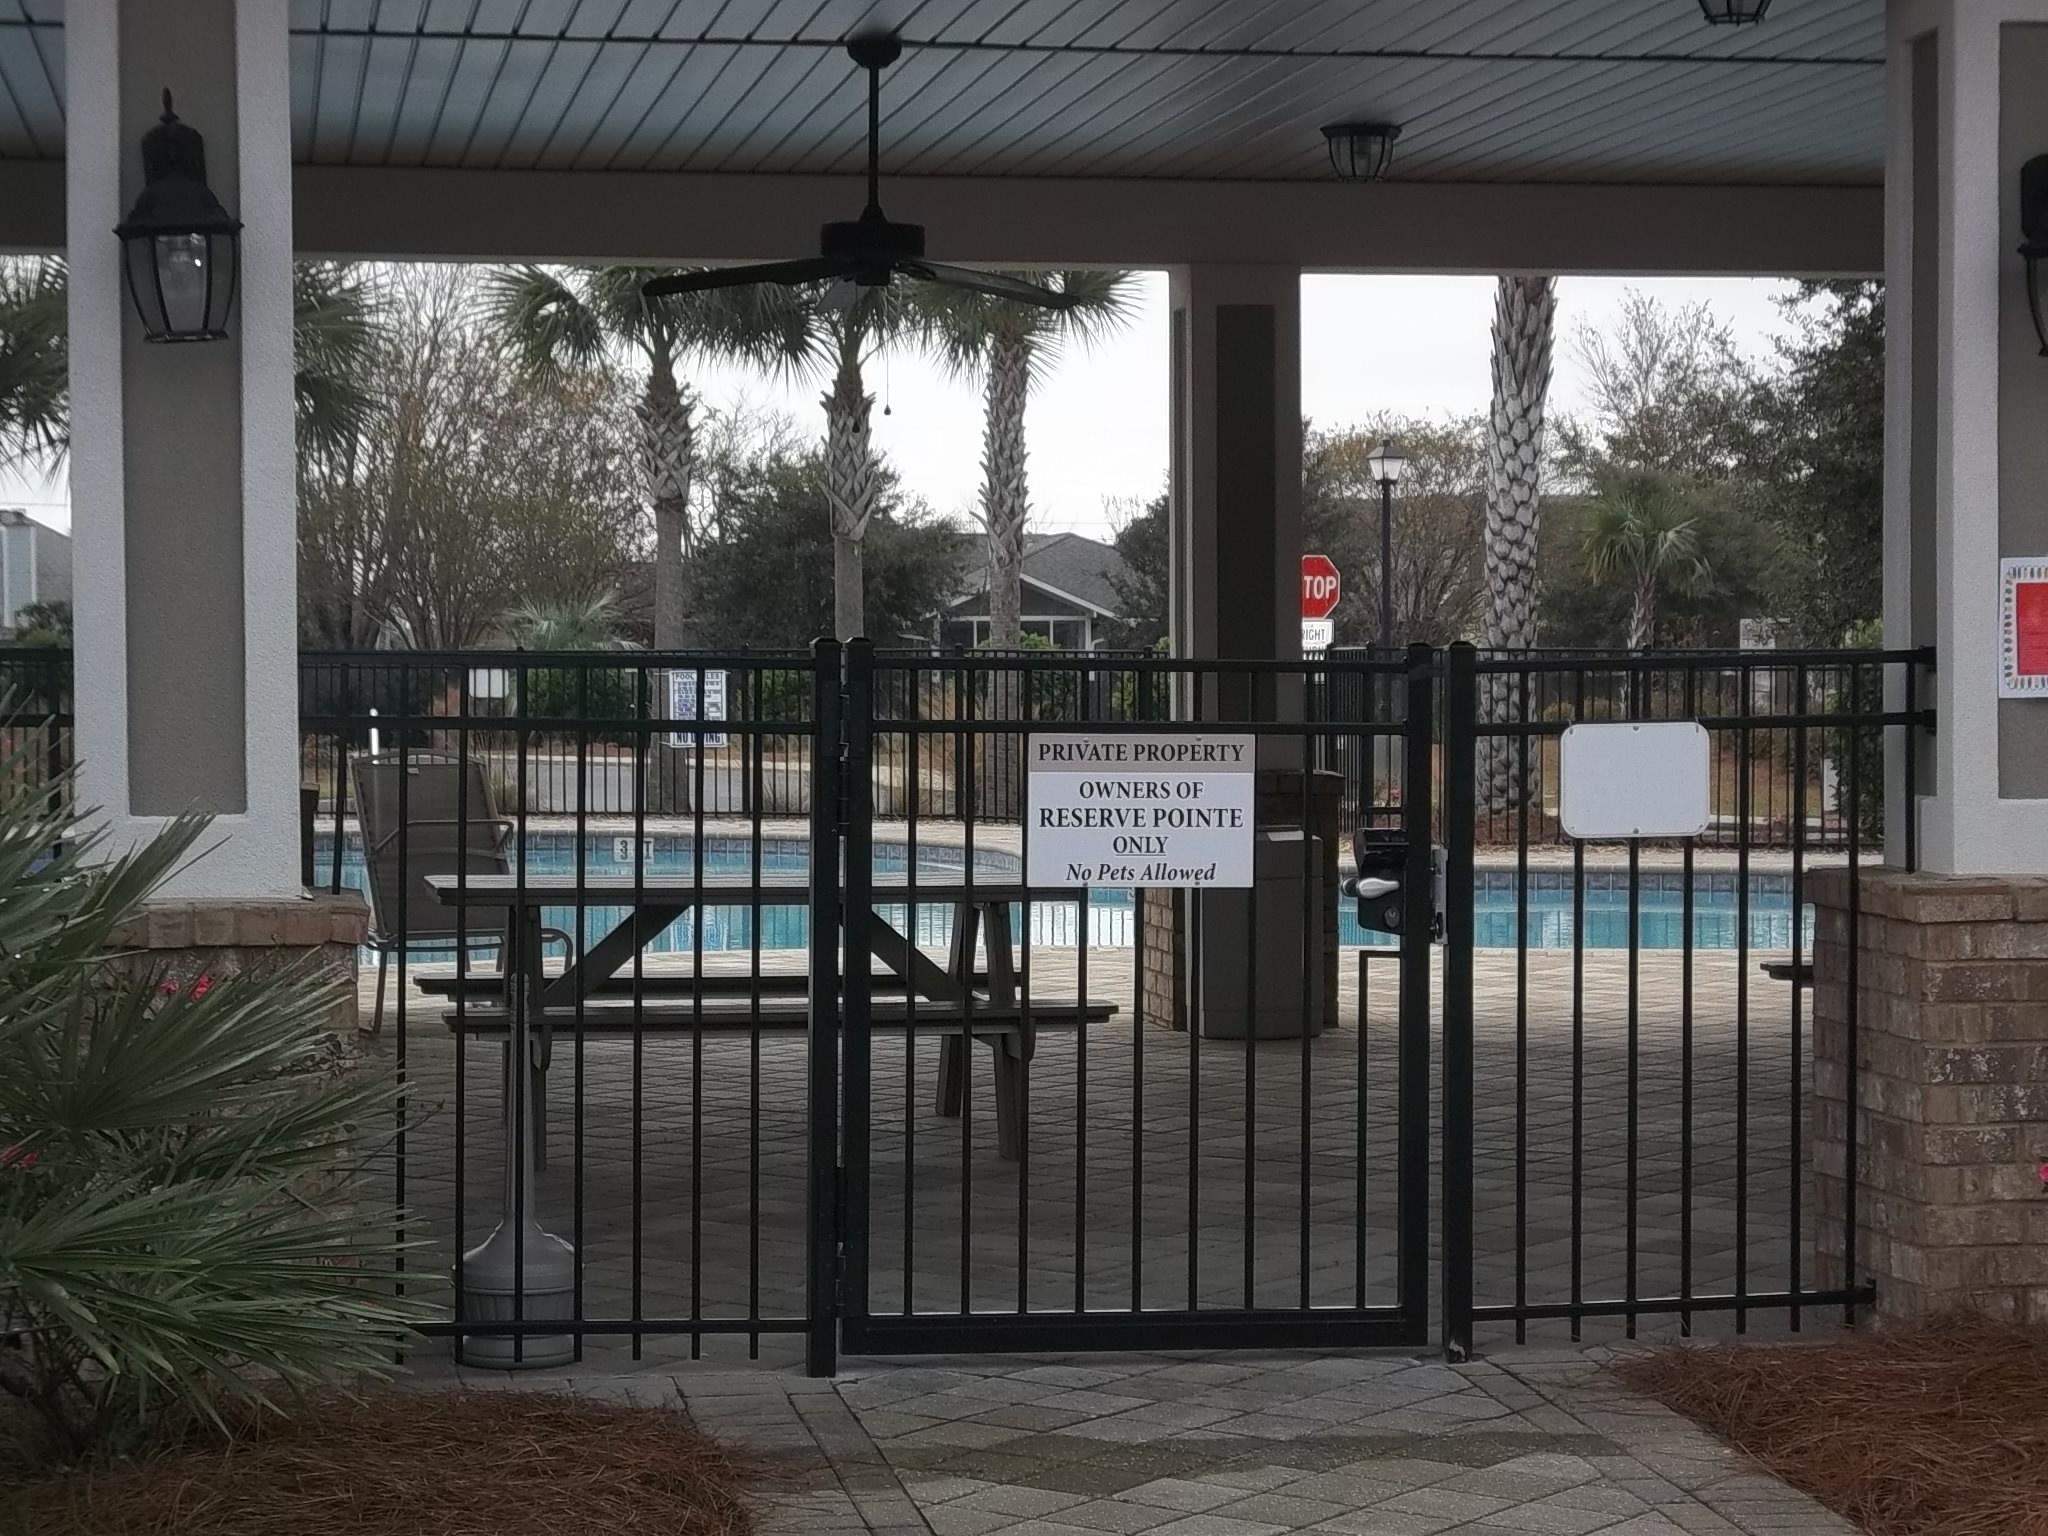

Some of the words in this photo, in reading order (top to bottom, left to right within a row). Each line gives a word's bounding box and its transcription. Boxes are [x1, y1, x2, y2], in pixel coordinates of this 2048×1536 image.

[1303, 575, 1337, 600] TOP
[1038, 743, 1128, 762] PRIVATE
[1133, 743, 1244, 762] PROPERTY
[1079, 781, 1171, 799] OWNERS
[1176, 781, 1204, 799] OF
[1039, 807, 1147, 828] RESERVE
[1152, 807, 1244, 828] POINTE
[1112, 836, 1169, 854] ONLY
[1065, 864, 1092, 881] No
[1096, 864, 1136, 881] Pets
[1139, 863, 1217, 881] Allowed
